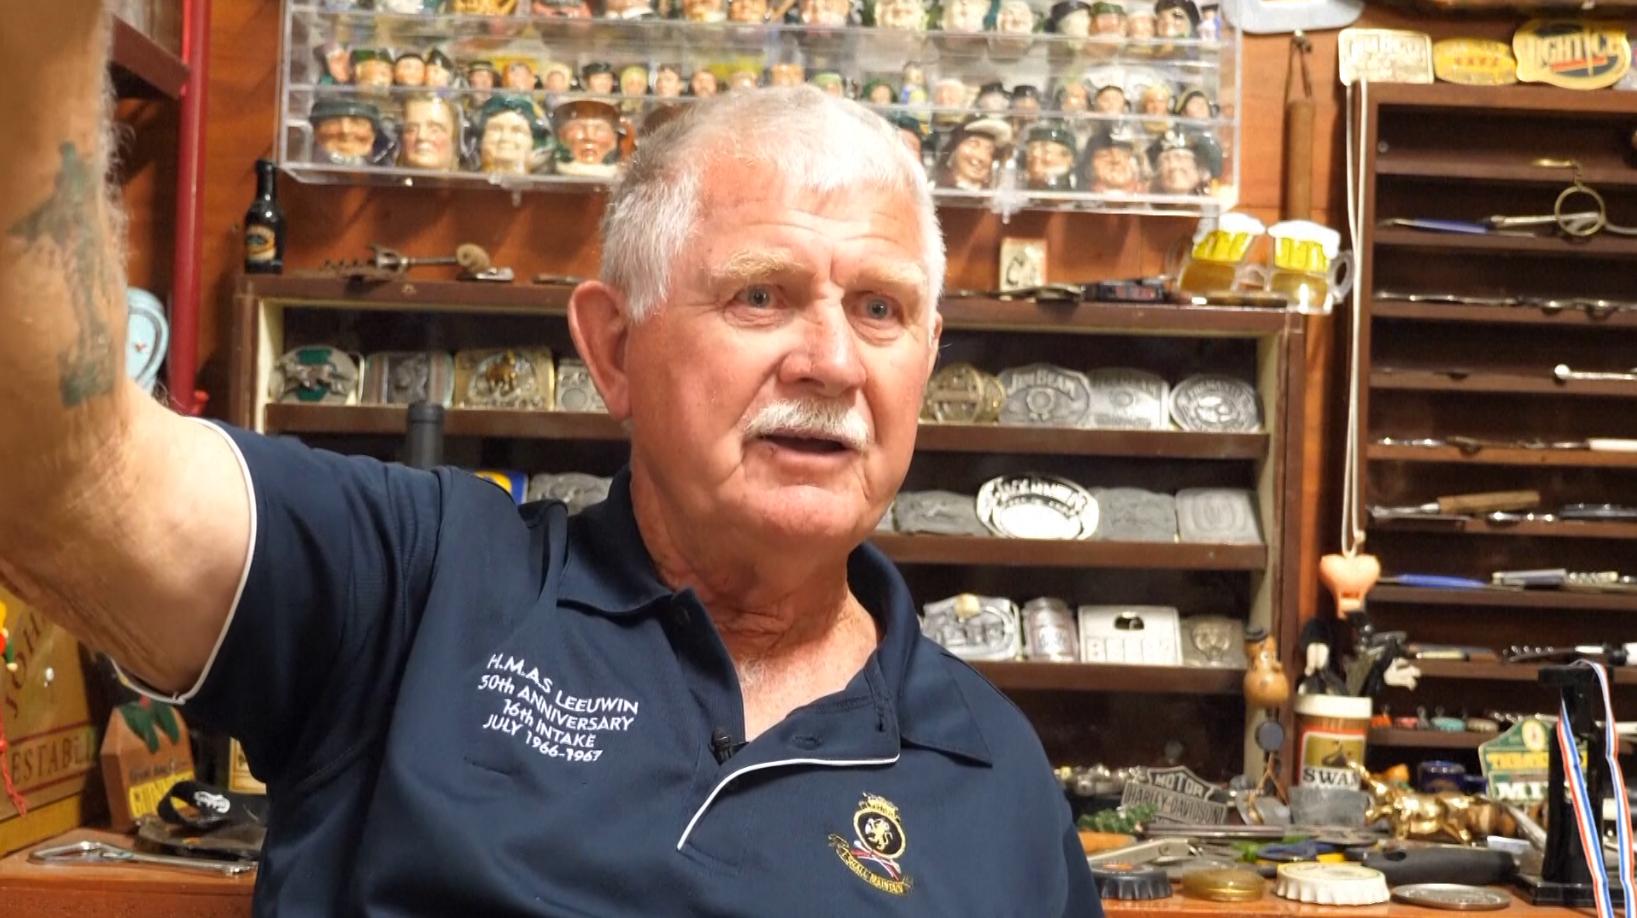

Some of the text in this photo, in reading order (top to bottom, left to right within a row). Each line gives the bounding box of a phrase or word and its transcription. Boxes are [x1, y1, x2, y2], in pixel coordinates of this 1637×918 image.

[1007, 373, 1035, 396] JIM
[1036, 370, 1076, 399] BEAM
[477, 675, 635, 731] 50th ANNIVERSARY
[555, 690, 639, 715] LEEUWIN
[482, 714, 603, 762] JULY 1966-1967
[503, 699, 597, 748] 16th INTAKE
[1154, 771, 1205, 799] MOTOR
